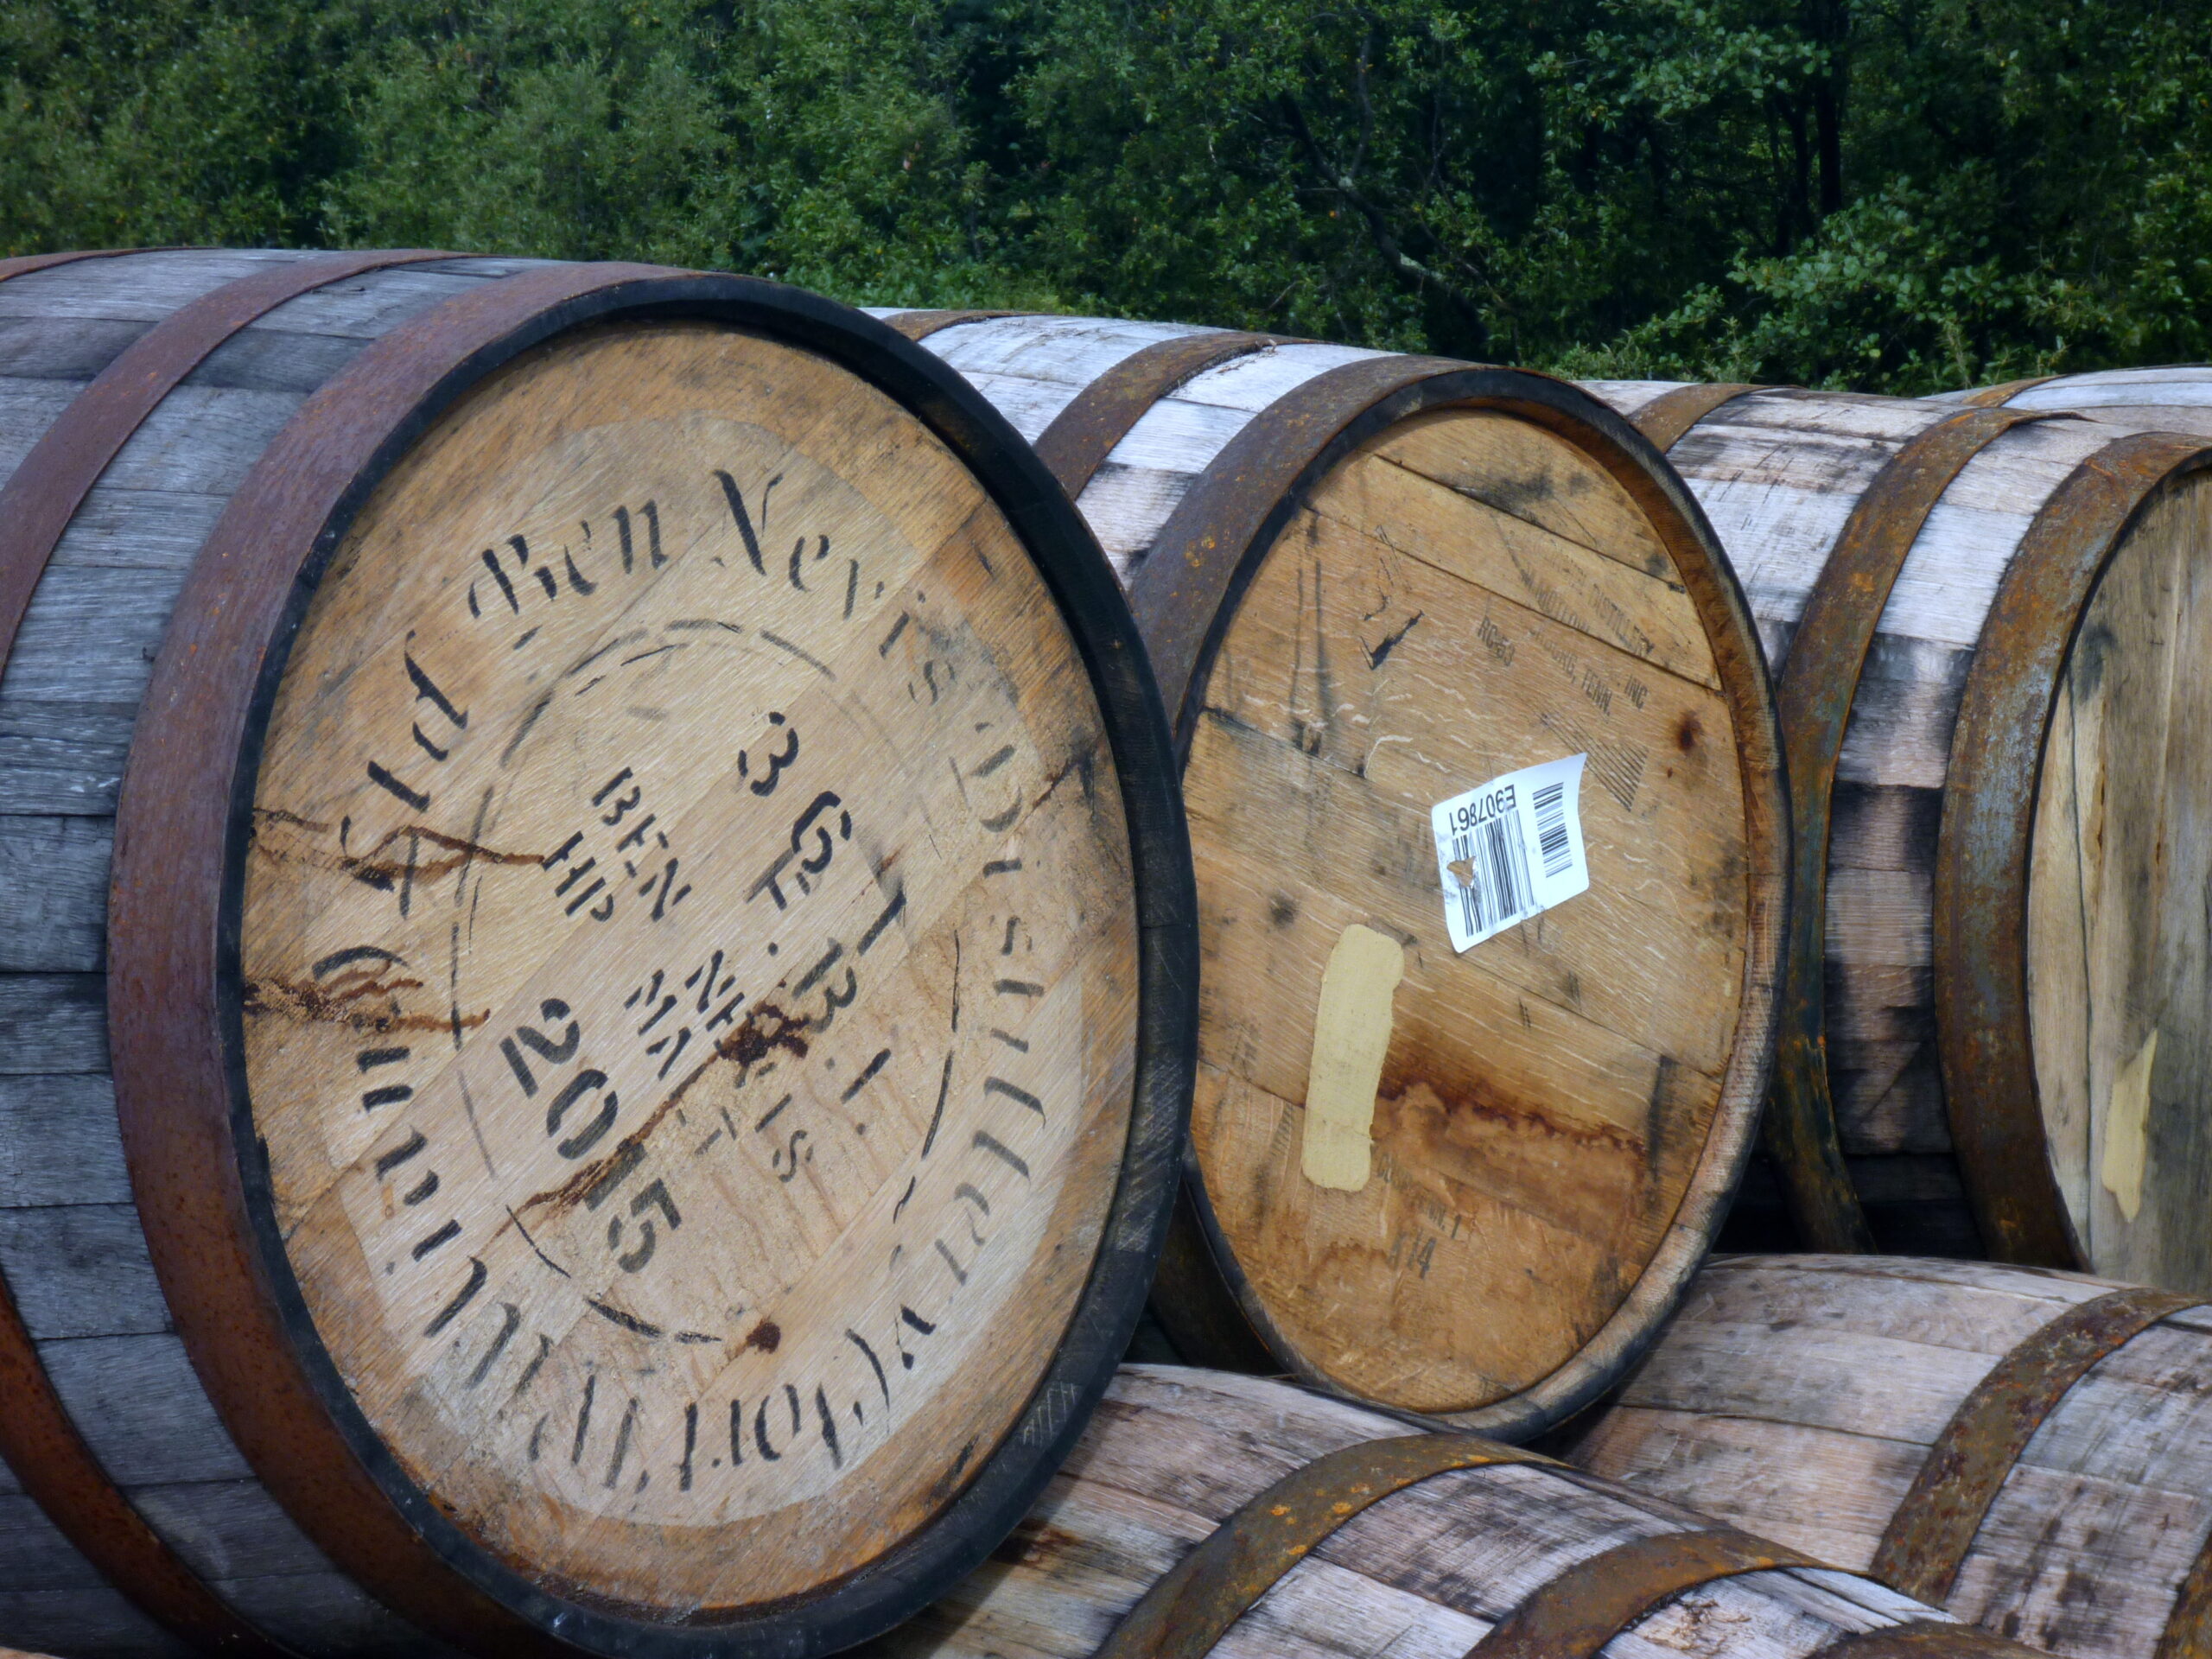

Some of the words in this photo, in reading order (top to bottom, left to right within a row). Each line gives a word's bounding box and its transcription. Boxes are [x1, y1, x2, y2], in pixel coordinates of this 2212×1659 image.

[467, 499, 669, 650] Ben
[711, 469, 956, 706] Nevis
[541, 830, 614, 923] HP
[591, 766, 692, 923] BEN
[737, 710, 907, 956] 361
[1448, 783, 1517, 836] E907861
[499, 997, 683, 1274] 2015
